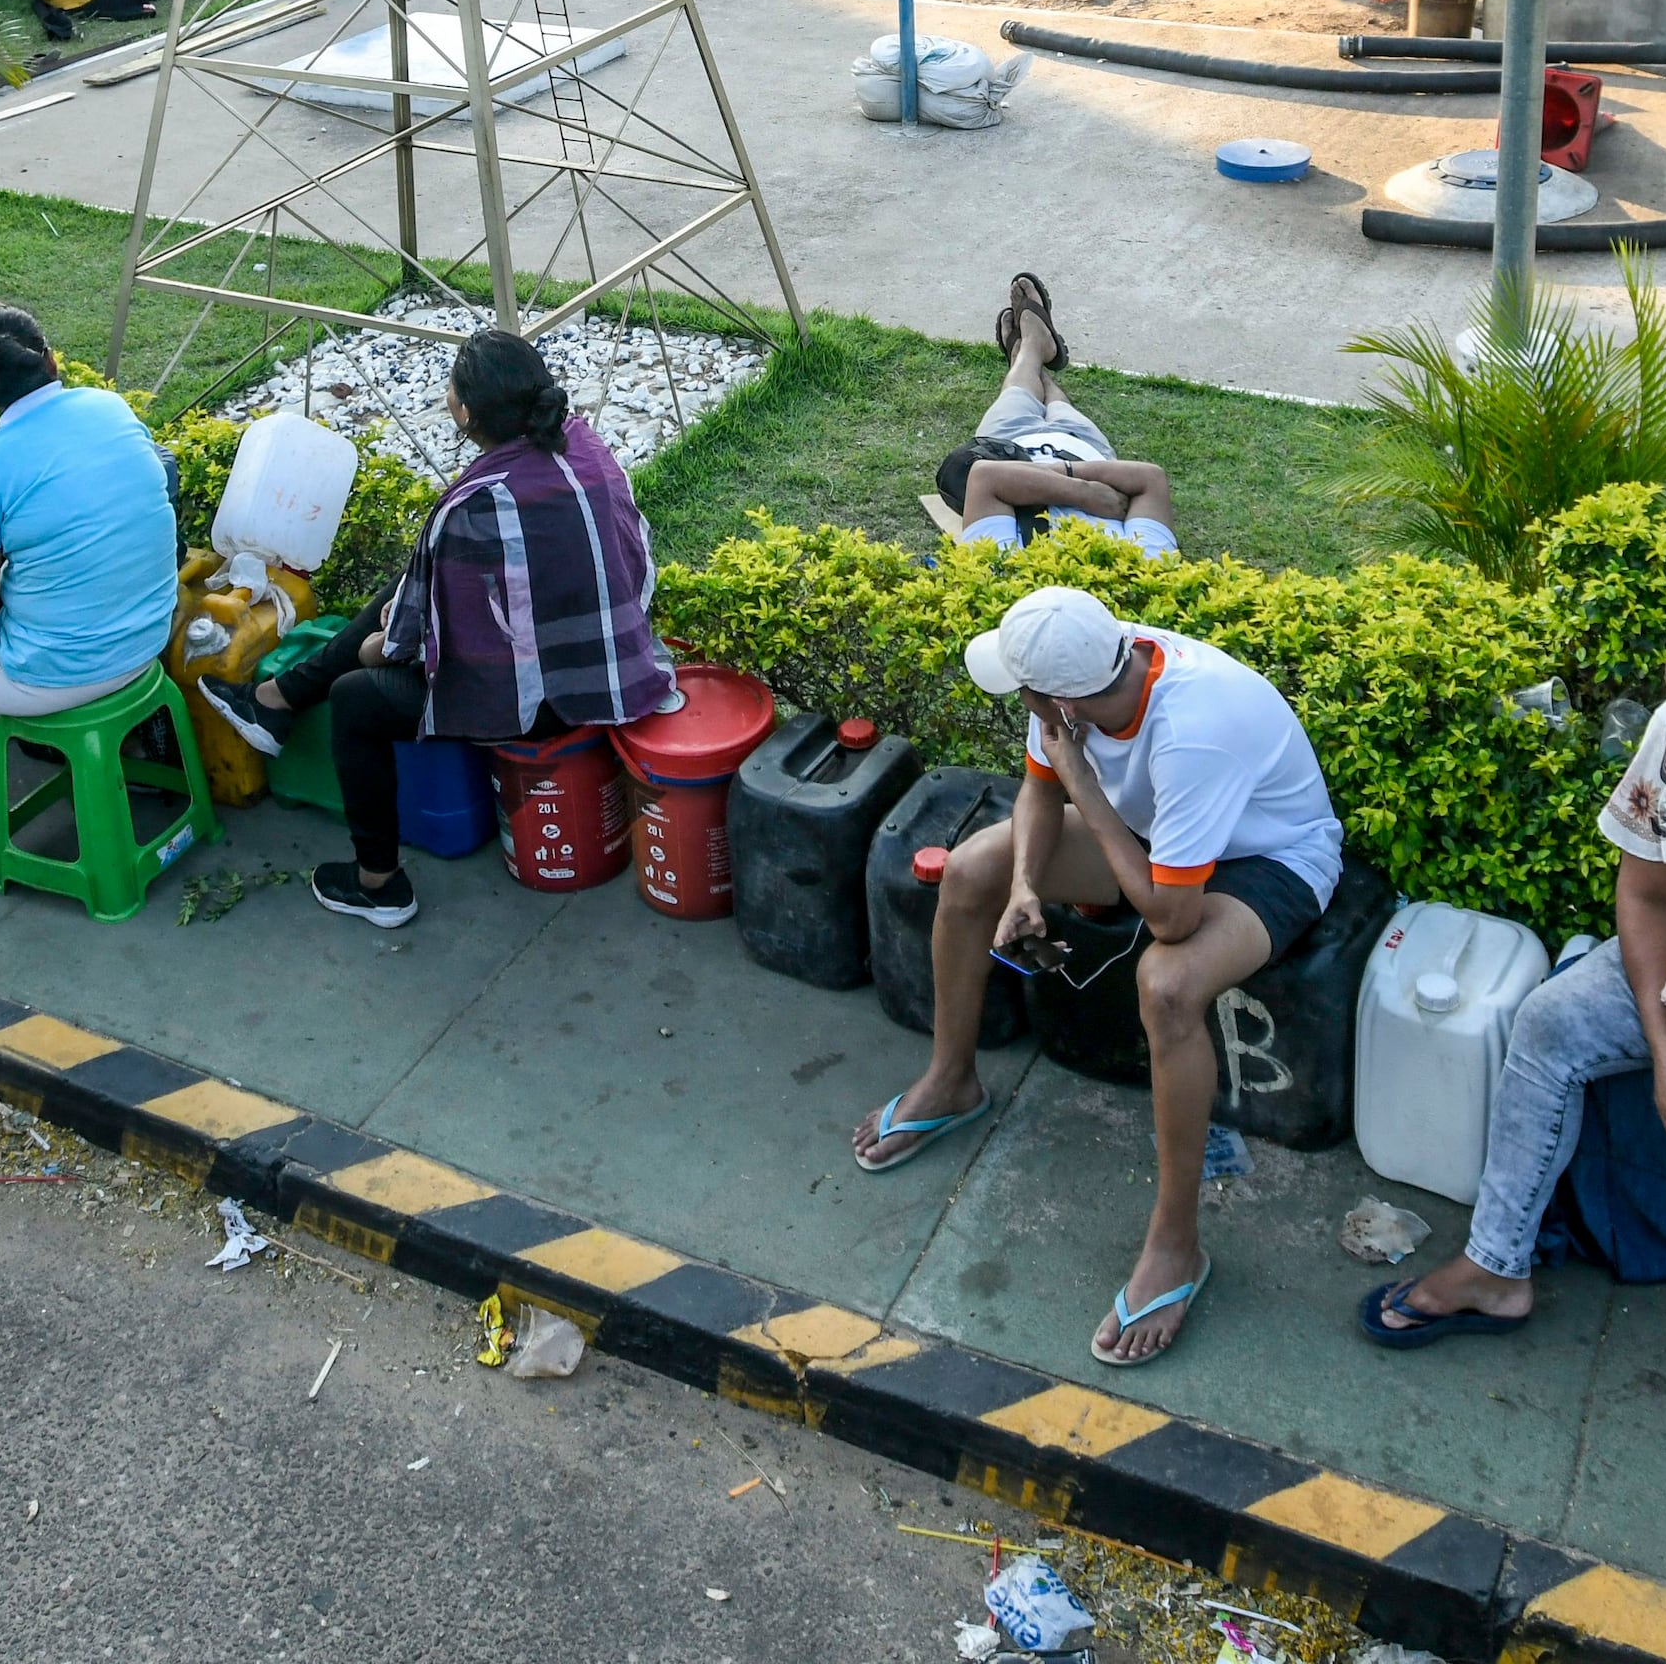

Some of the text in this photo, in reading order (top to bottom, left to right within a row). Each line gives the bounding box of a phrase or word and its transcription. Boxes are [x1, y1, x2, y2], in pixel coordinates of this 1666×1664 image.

[538, 803, 559, 814] 20 L
[647, 823, 665, 839] 20 L
[1216, 987, 1294, 1109] B
